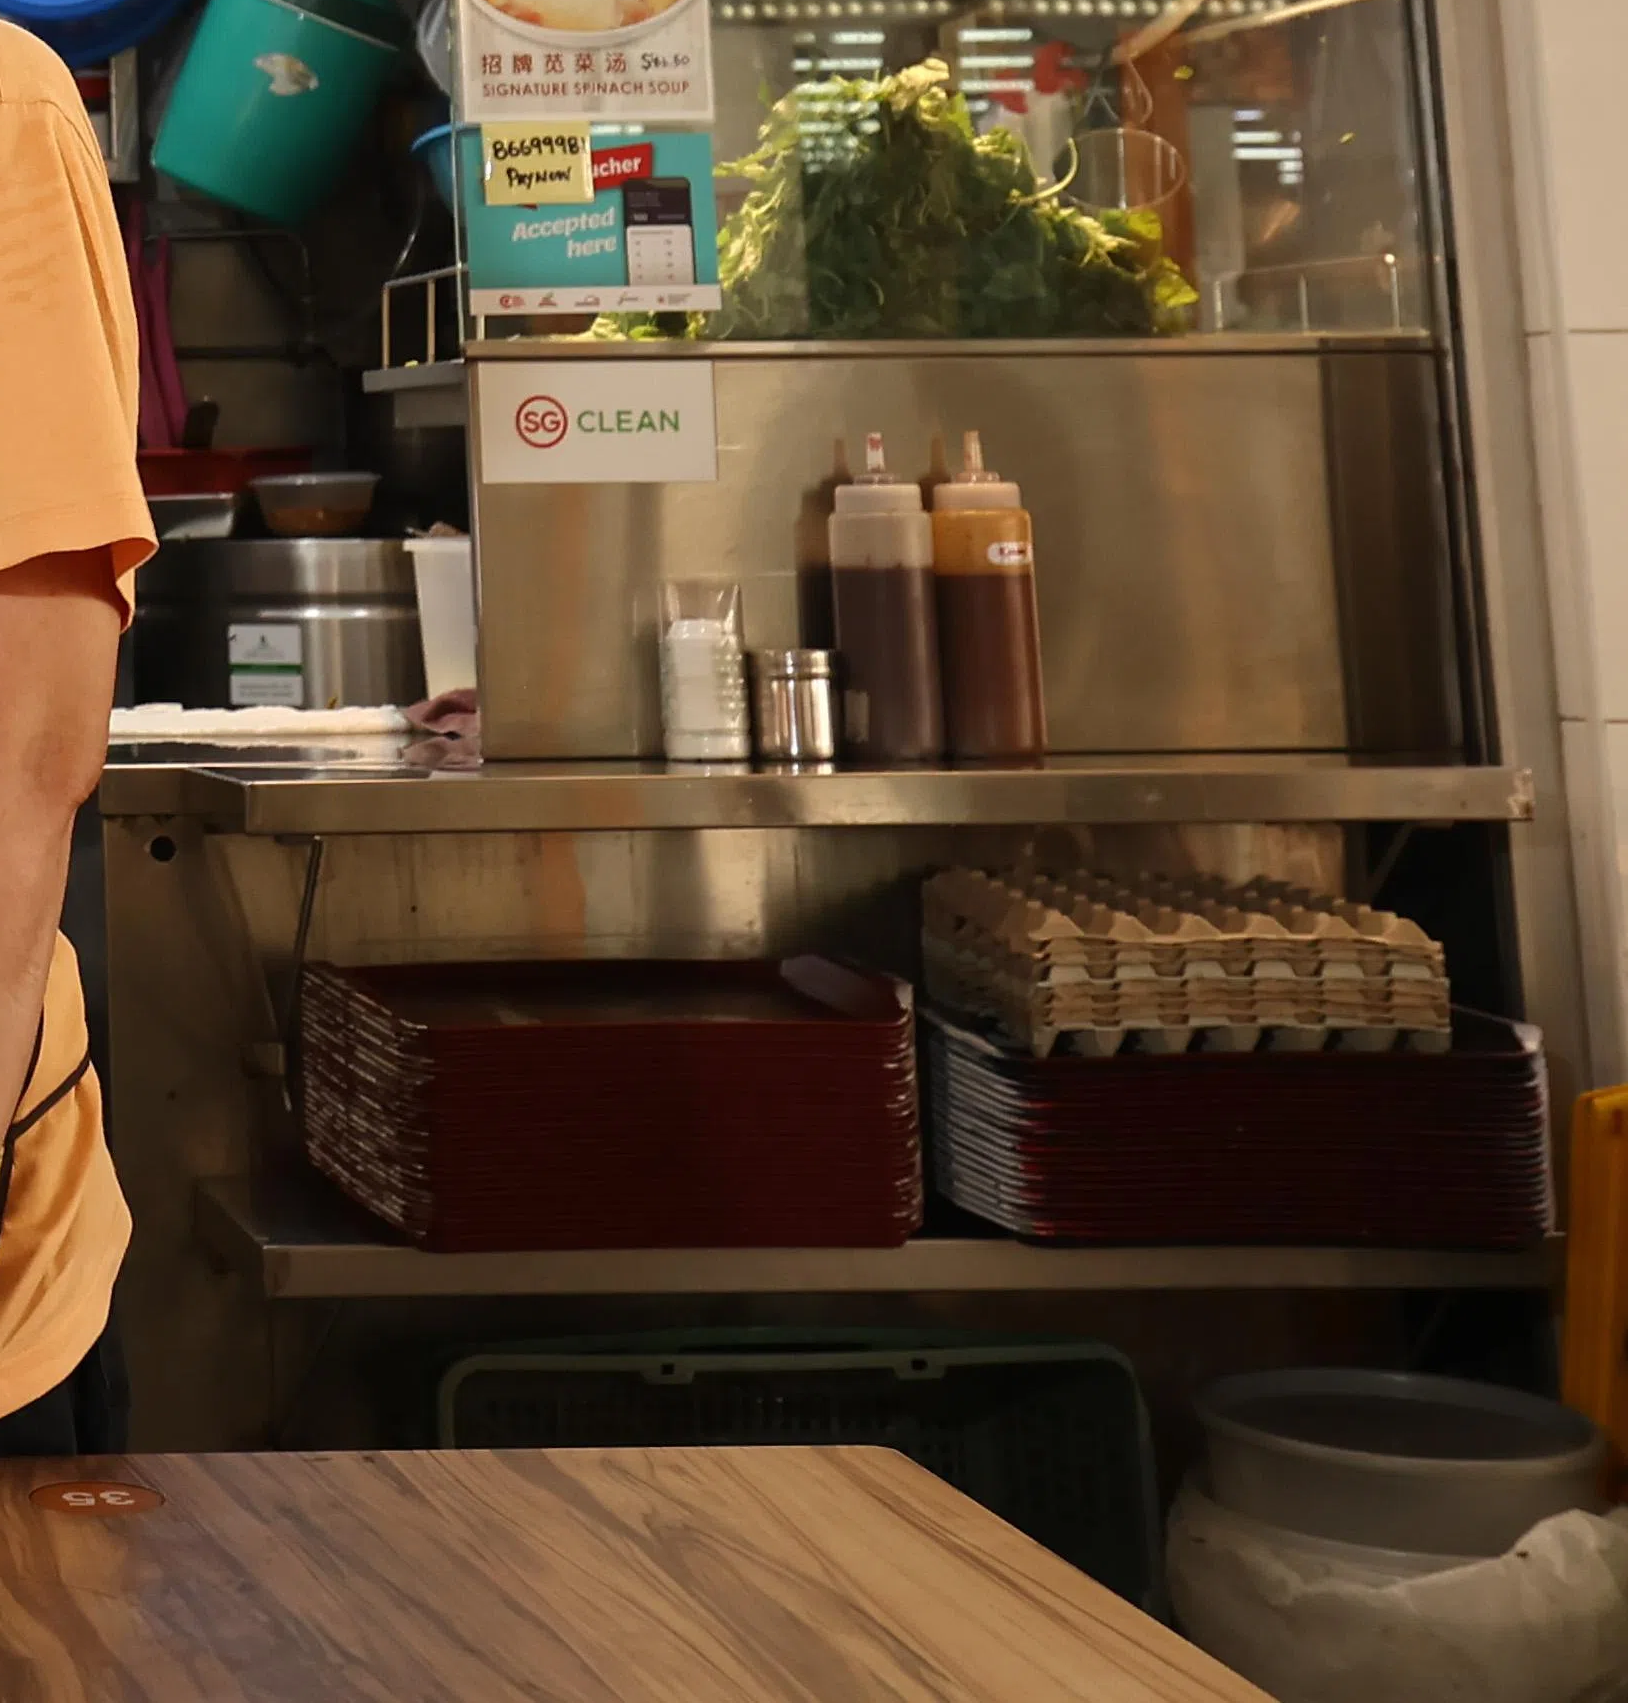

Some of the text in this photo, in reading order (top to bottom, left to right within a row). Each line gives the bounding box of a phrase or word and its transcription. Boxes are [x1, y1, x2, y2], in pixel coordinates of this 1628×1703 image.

[482, 80, 690, 98] SIGNATURE SPINACH SOUP
[593, 157, 642, 178] cher
[511, 205, 616, 242] Accepted
[566, 234, 617, 258] here
[523, 409, 681, 434] SG CLEAN
